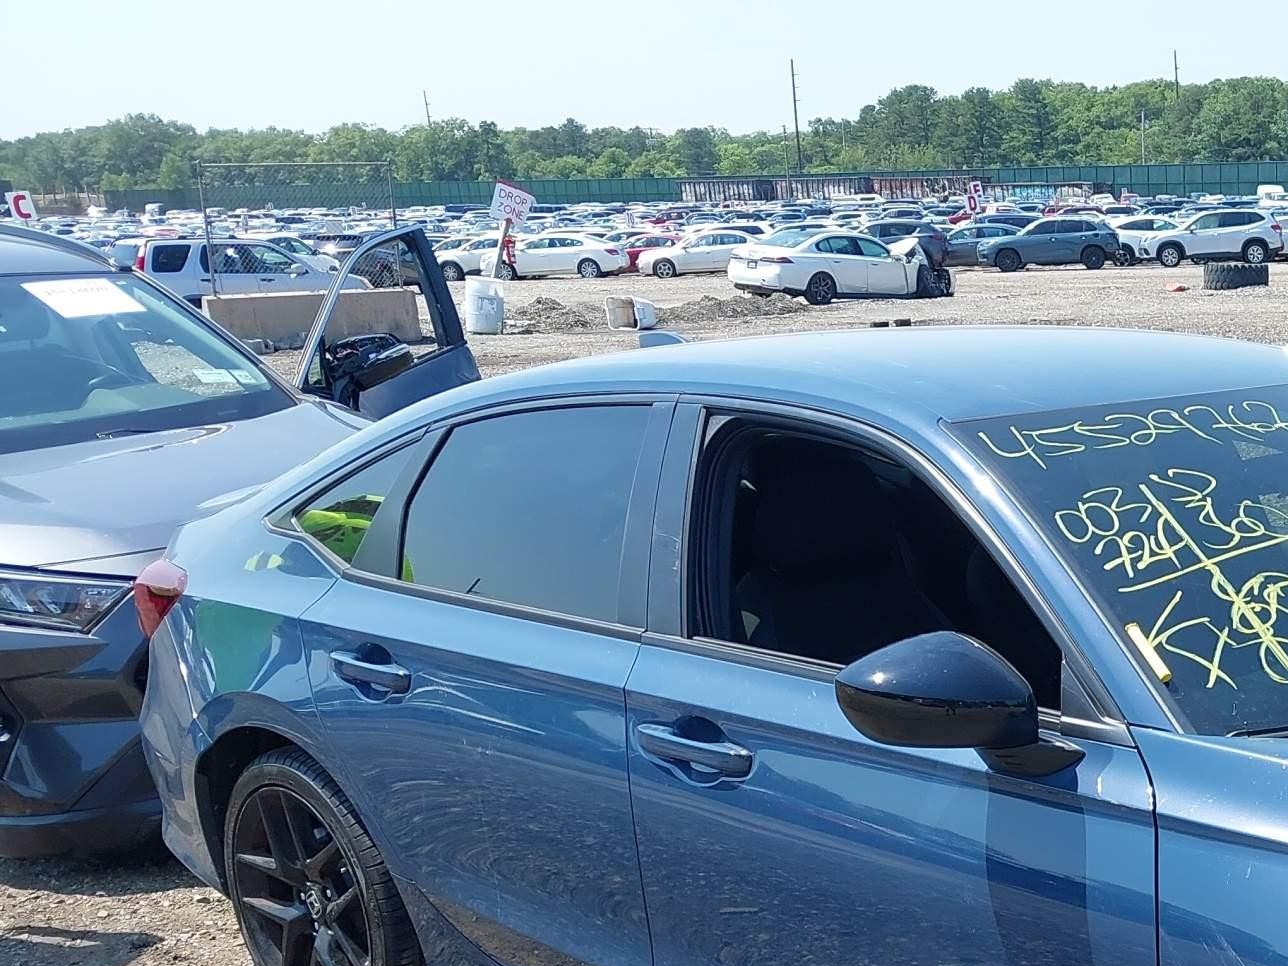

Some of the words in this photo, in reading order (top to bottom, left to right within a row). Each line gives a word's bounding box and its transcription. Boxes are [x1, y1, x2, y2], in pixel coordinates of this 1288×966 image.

[13, 194, 32, 219] C
[498, 188, 528, 206] DROP
[968, 195, 977, 211] D
[497, 201, 525, 221] ZONE
